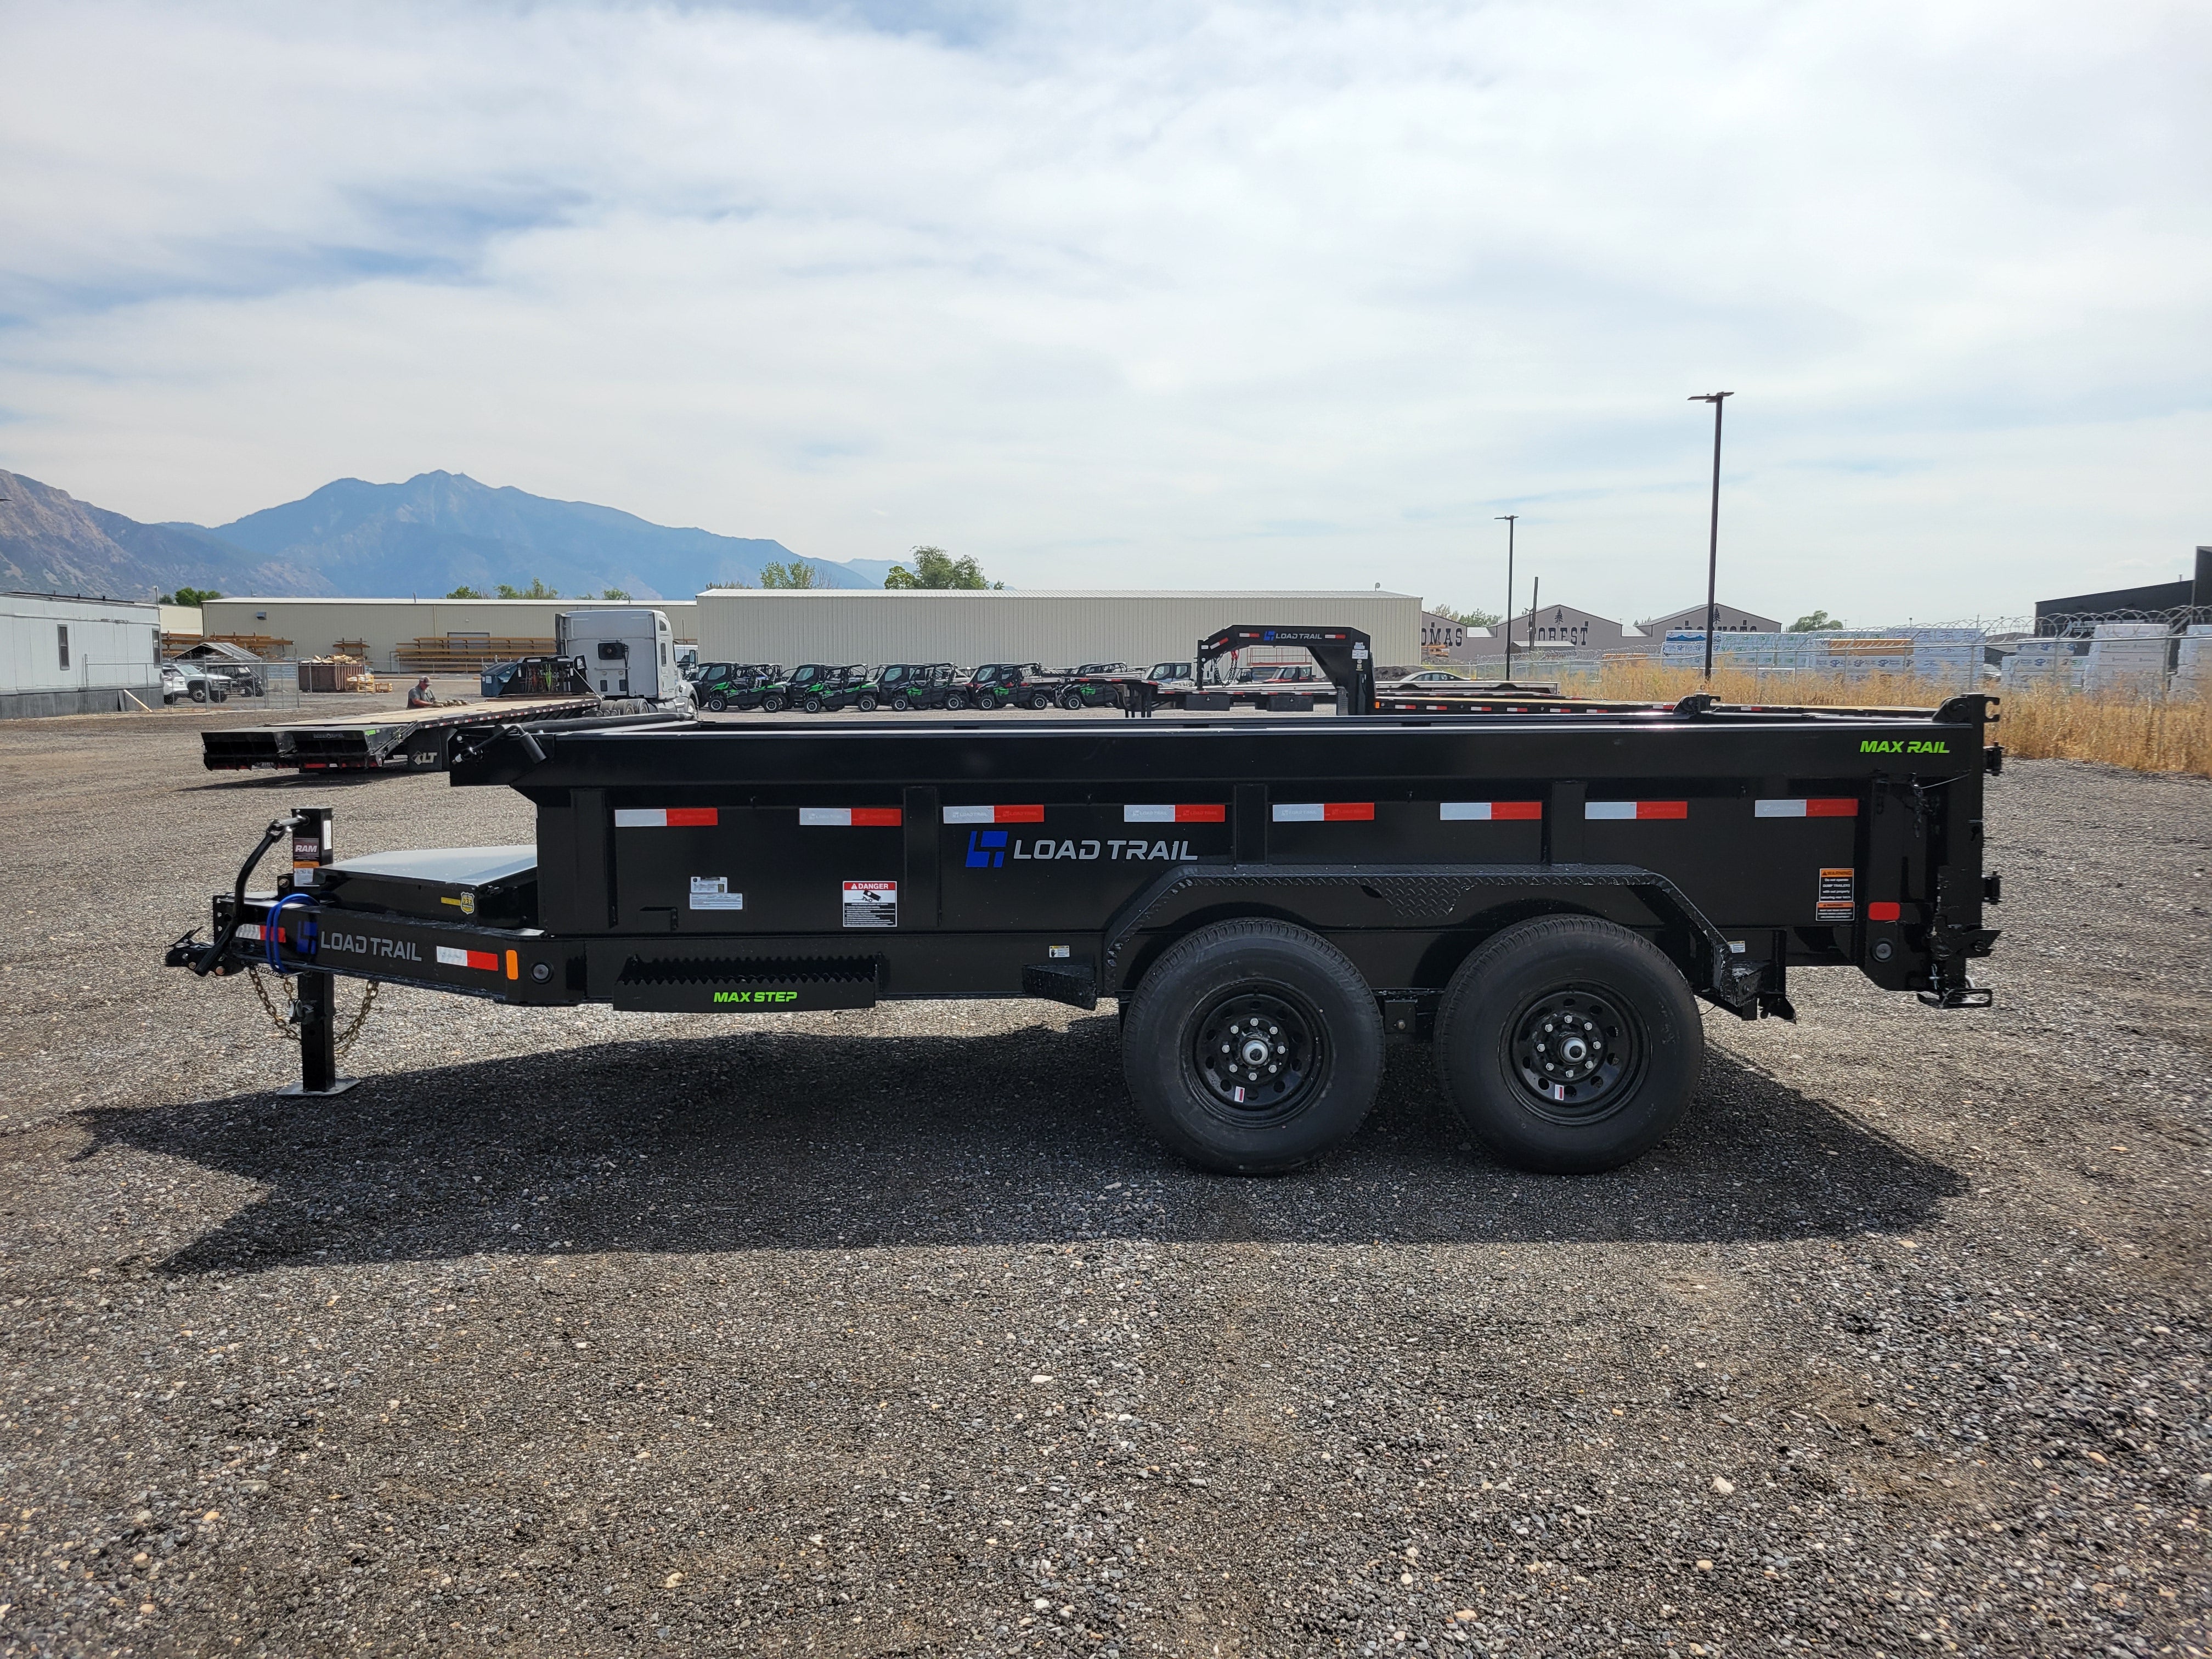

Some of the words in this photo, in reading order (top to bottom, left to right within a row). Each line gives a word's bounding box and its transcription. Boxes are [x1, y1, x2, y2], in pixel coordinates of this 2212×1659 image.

[1534, 627, 1588, 646] OREST
[1860, 741, 1905, 753] MAX
[1906, 741, 1950, 754] RAIL
[295, 844, 318, 853] RAM
[1013, 839, 1101, 860] LOAD
[1107, 840, 1198, 860] TRAIL
[320, 931, 367, 954] LOAD
[370, 937, 422, 962] TRAIL
[713, 992, 752, 1002] MAX
[753, 991, 798, 1002] STEP
